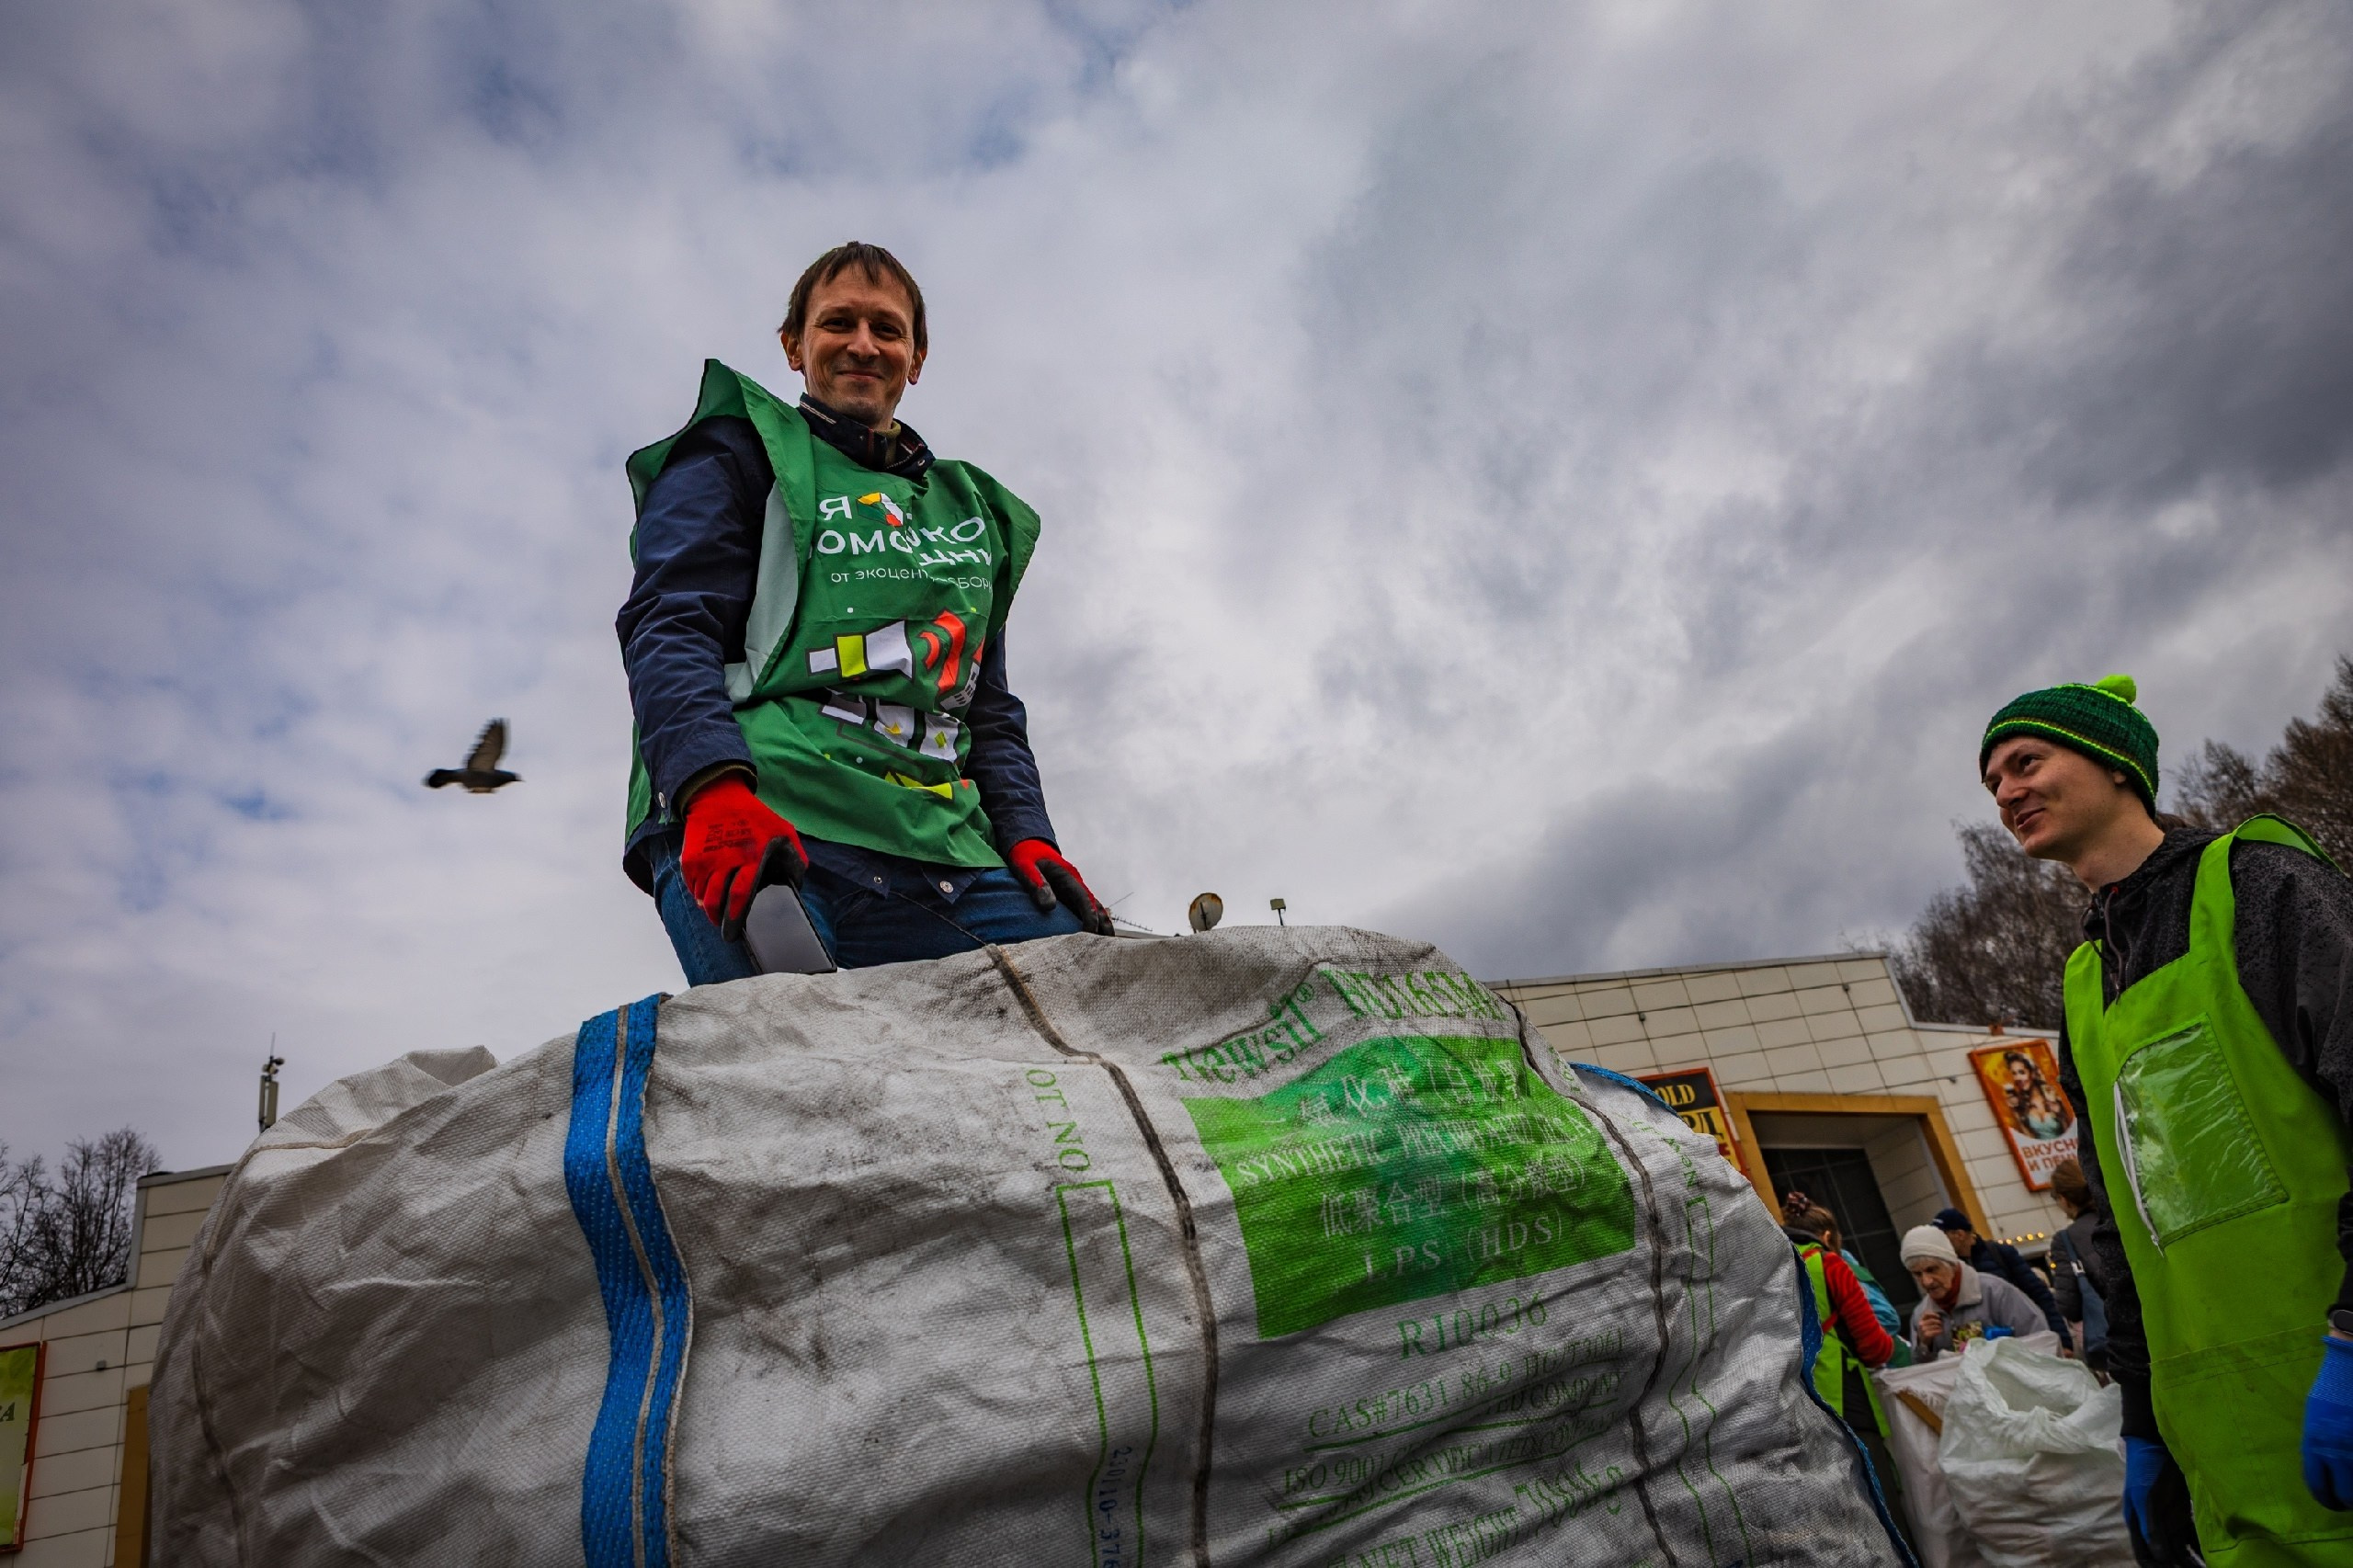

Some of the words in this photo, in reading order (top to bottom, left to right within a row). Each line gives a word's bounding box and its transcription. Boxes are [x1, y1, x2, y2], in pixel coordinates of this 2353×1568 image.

[819, 495, 853, 520] Я
[831, 573, 850, 583] ОТ
[1236, 1127, 1387, 1187] SYNTHETIC
